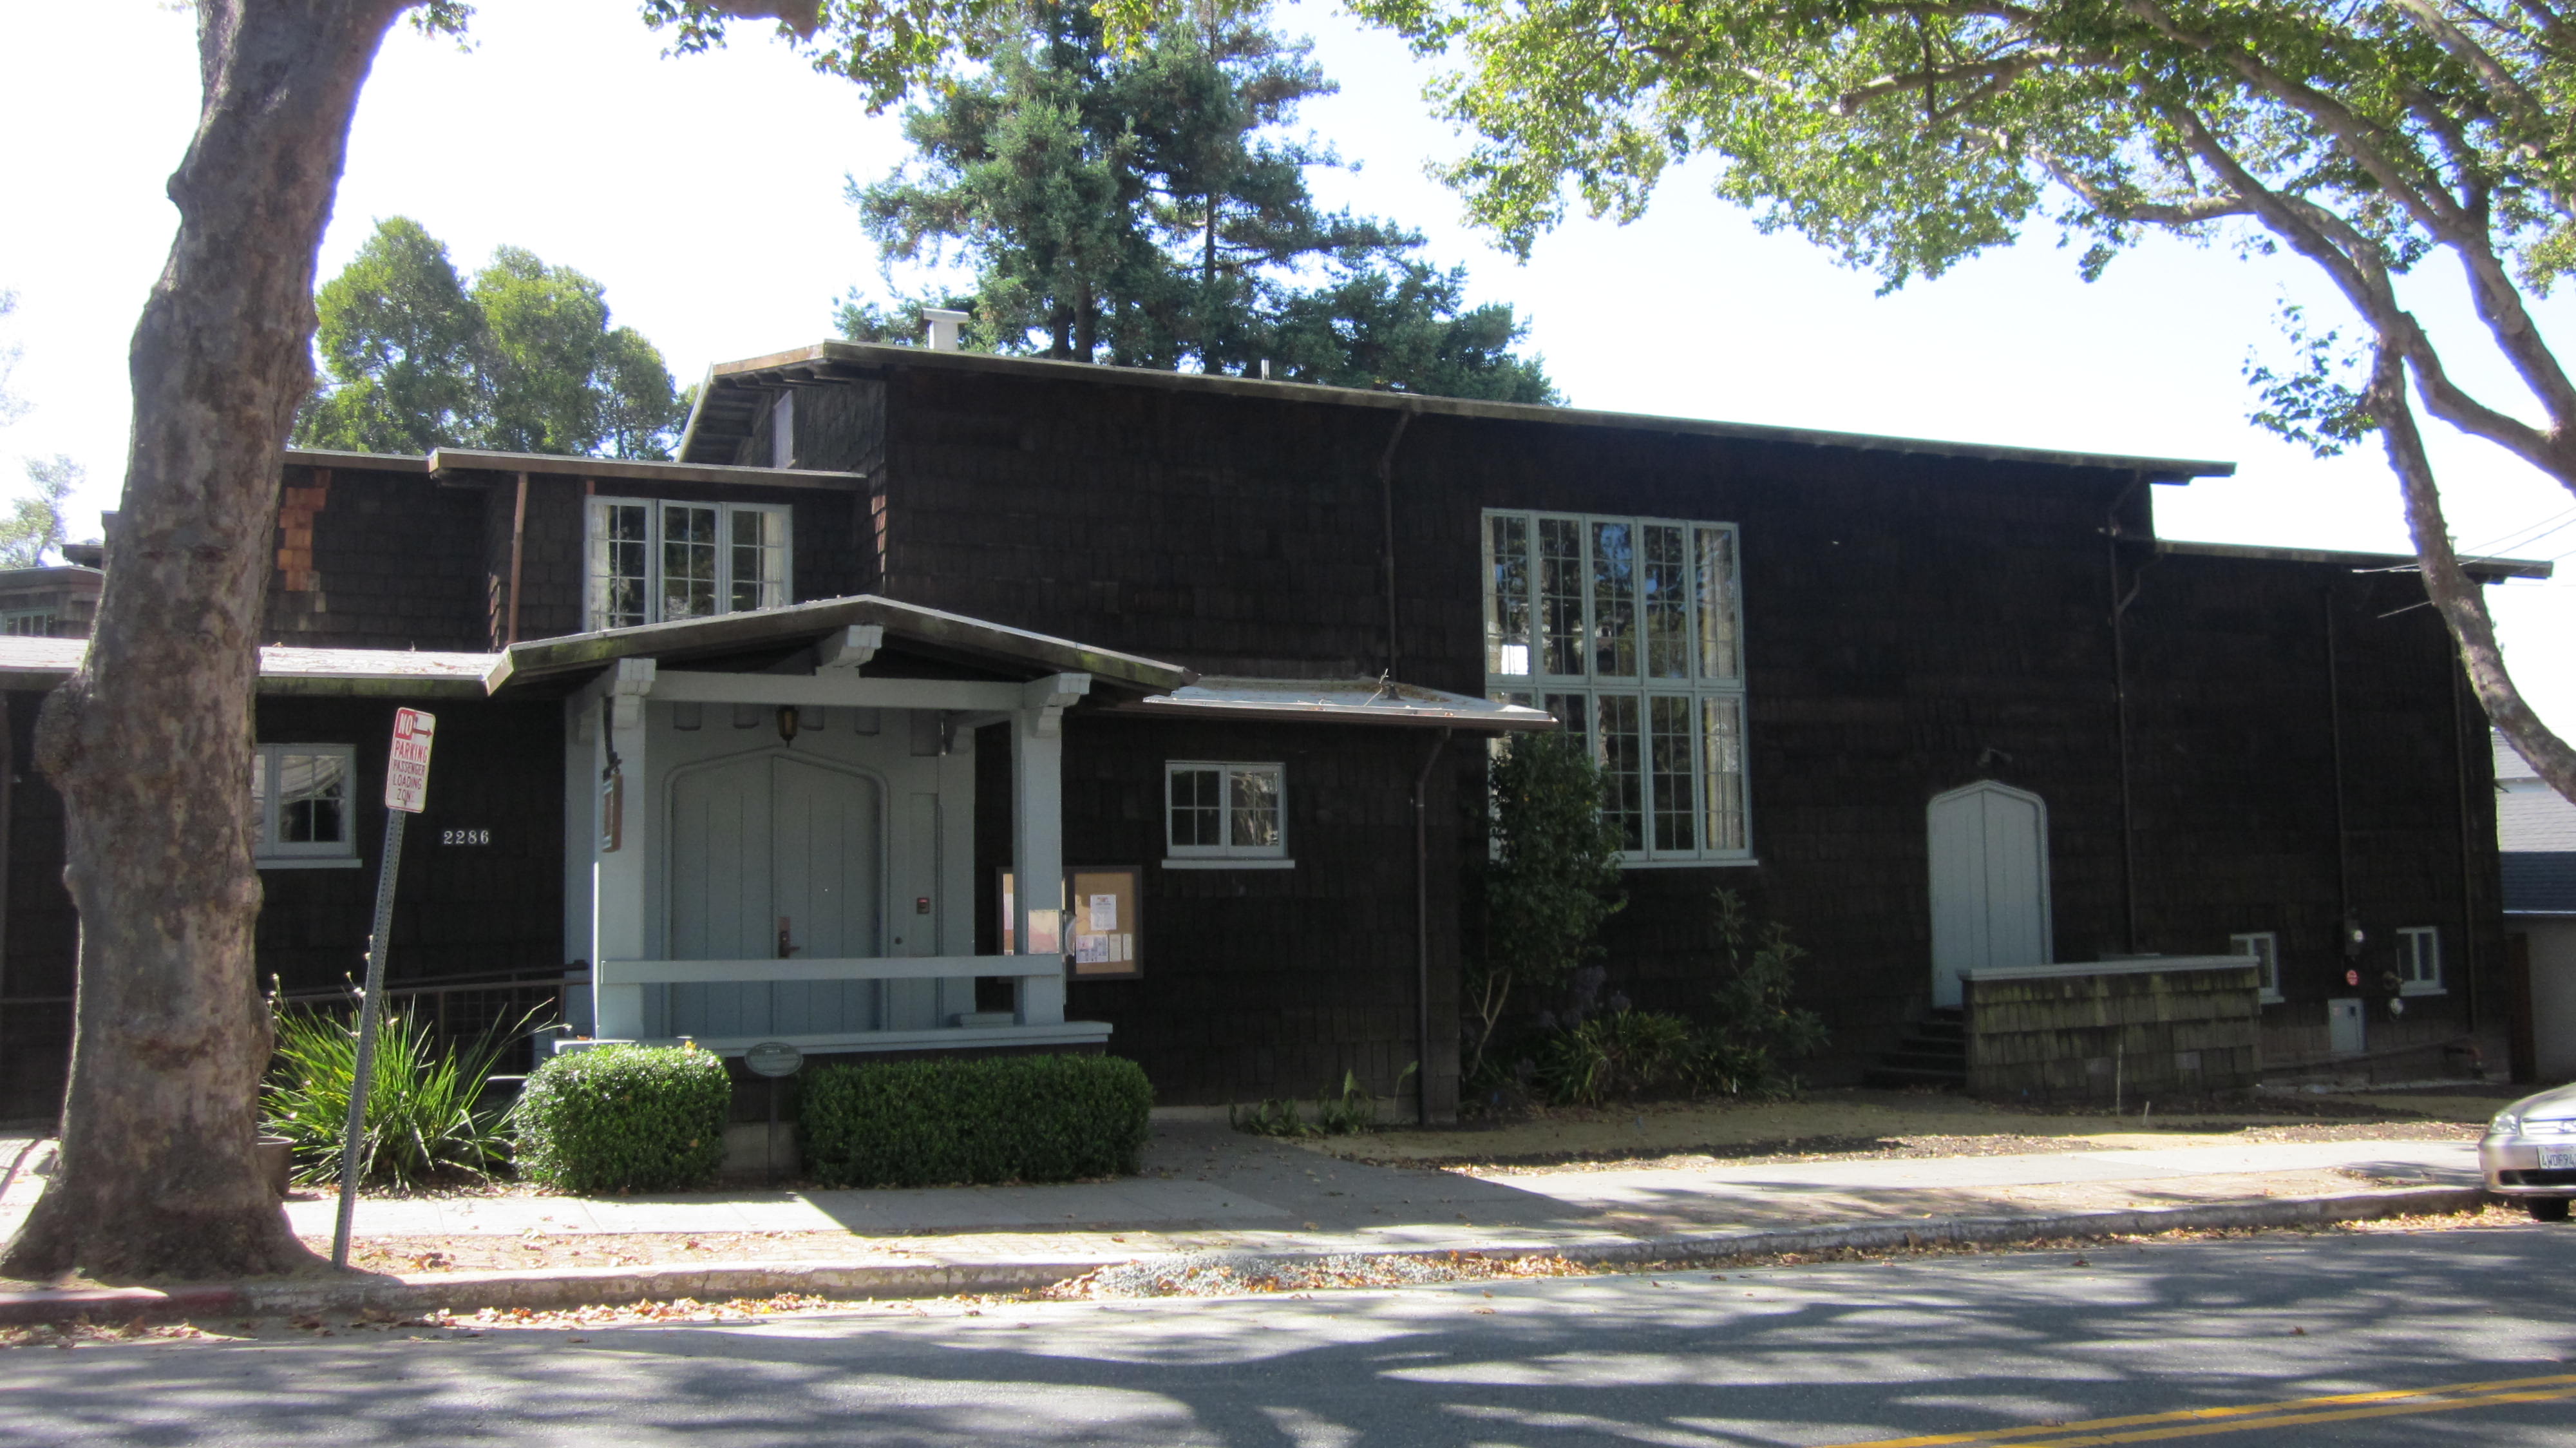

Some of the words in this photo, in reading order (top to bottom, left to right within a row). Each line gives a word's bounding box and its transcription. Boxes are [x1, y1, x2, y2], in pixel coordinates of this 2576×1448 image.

[399, 713, 413, 736] NO
[394, 740, 428, 763] PARKING
[393, 760, 425, 777] PASSENGER
[393, 774, 422, 790] LOADING
[443, 830, 489, 844] 2286
[2541, 1154, 2576, 1167] 4WDF94
